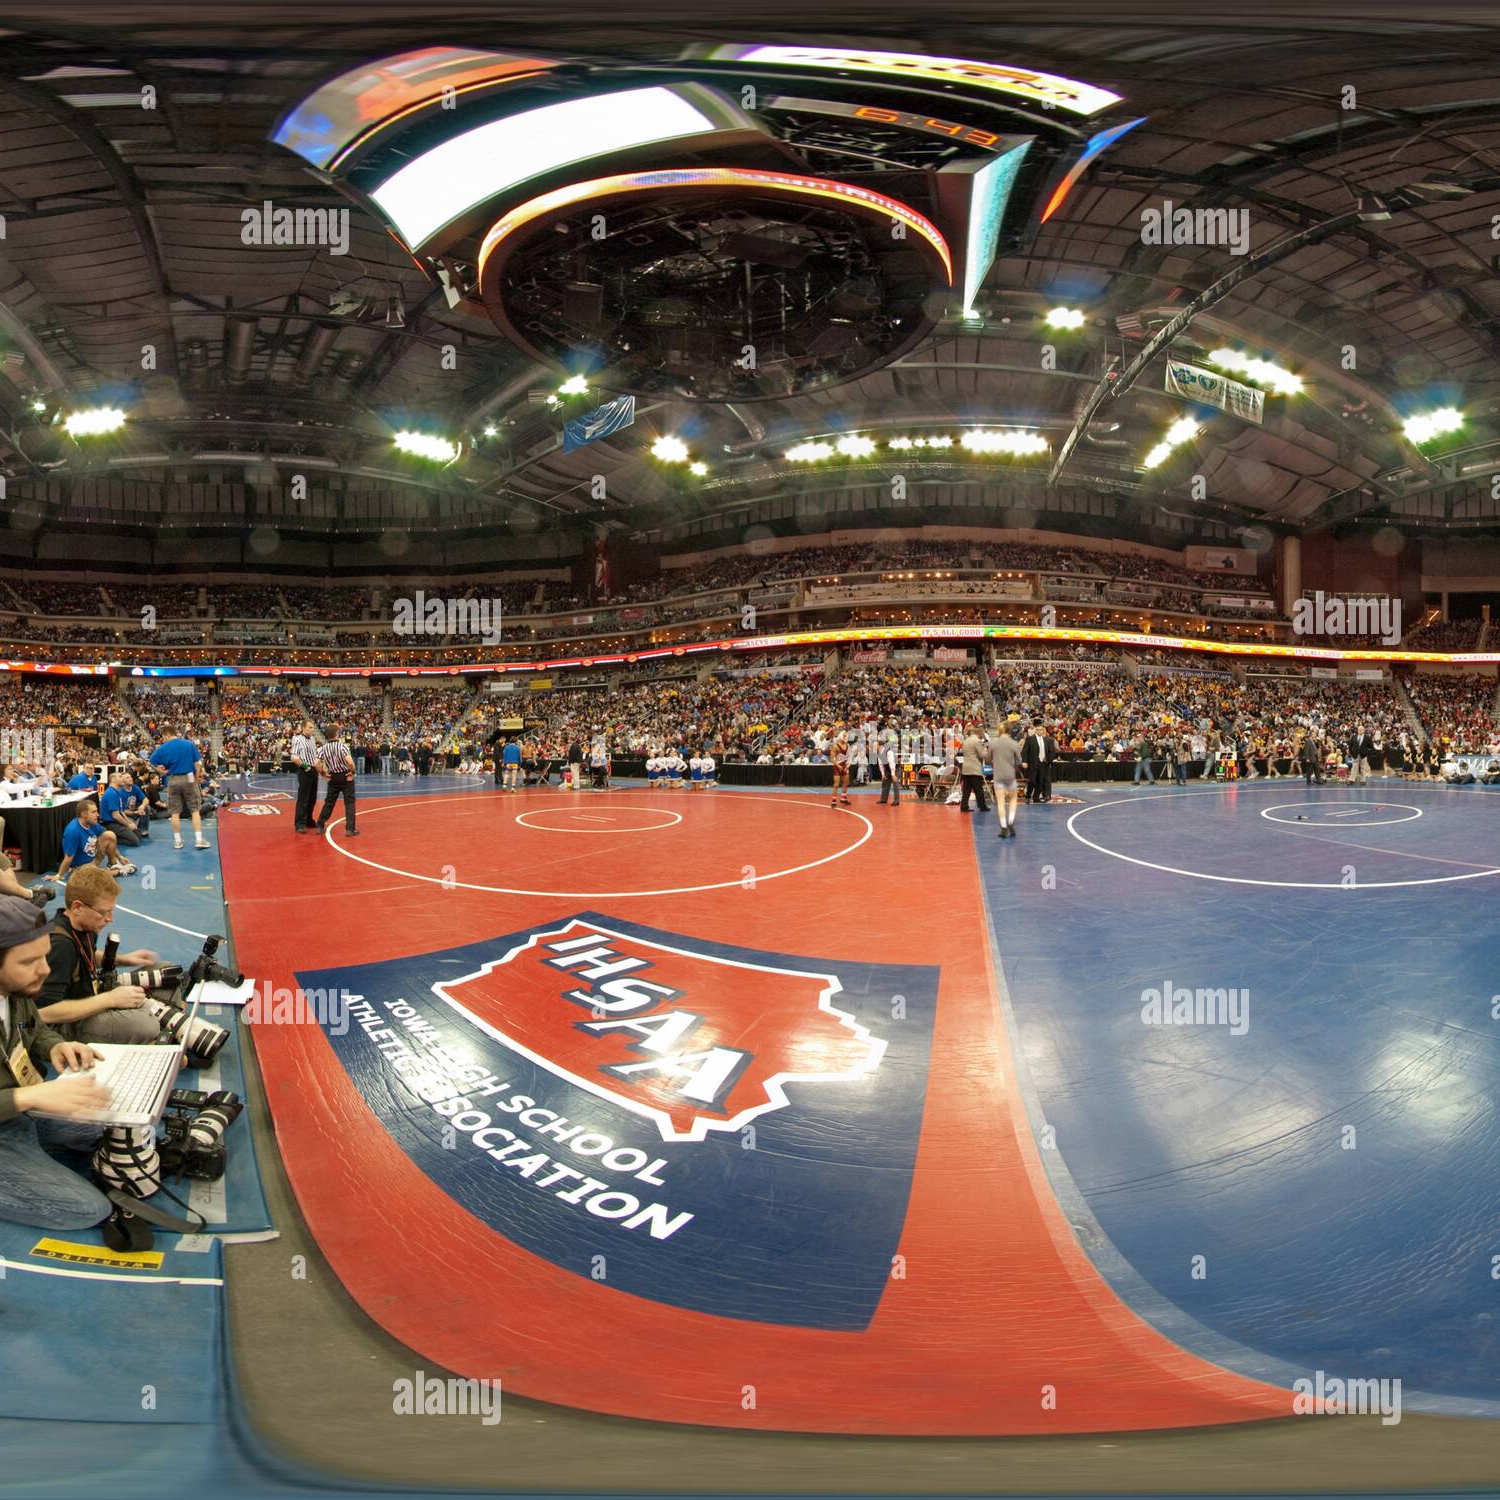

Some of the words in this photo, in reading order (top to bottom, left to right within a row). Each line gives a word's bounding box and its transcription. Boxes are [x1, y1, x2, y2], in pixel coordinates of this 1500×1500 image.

[853, 106, 1000, 147] 6:43
[940, 628, 957, 637] ALL
[958, 628, 981, 637] GOOD
[1051, 662, 1107, 671] CONSTRUCTION
[542, 933, 752, 1110] IHSAA
[384, 997, 443, 1047] IOWA
[496, 1094, 669, 1187] SCHOOL
[340, 992, 423, 1073] ATHLETIC
[413, 1062, 696, 1240] ASSOCIATION
[45, 1251, 145, 1269] WARNING
